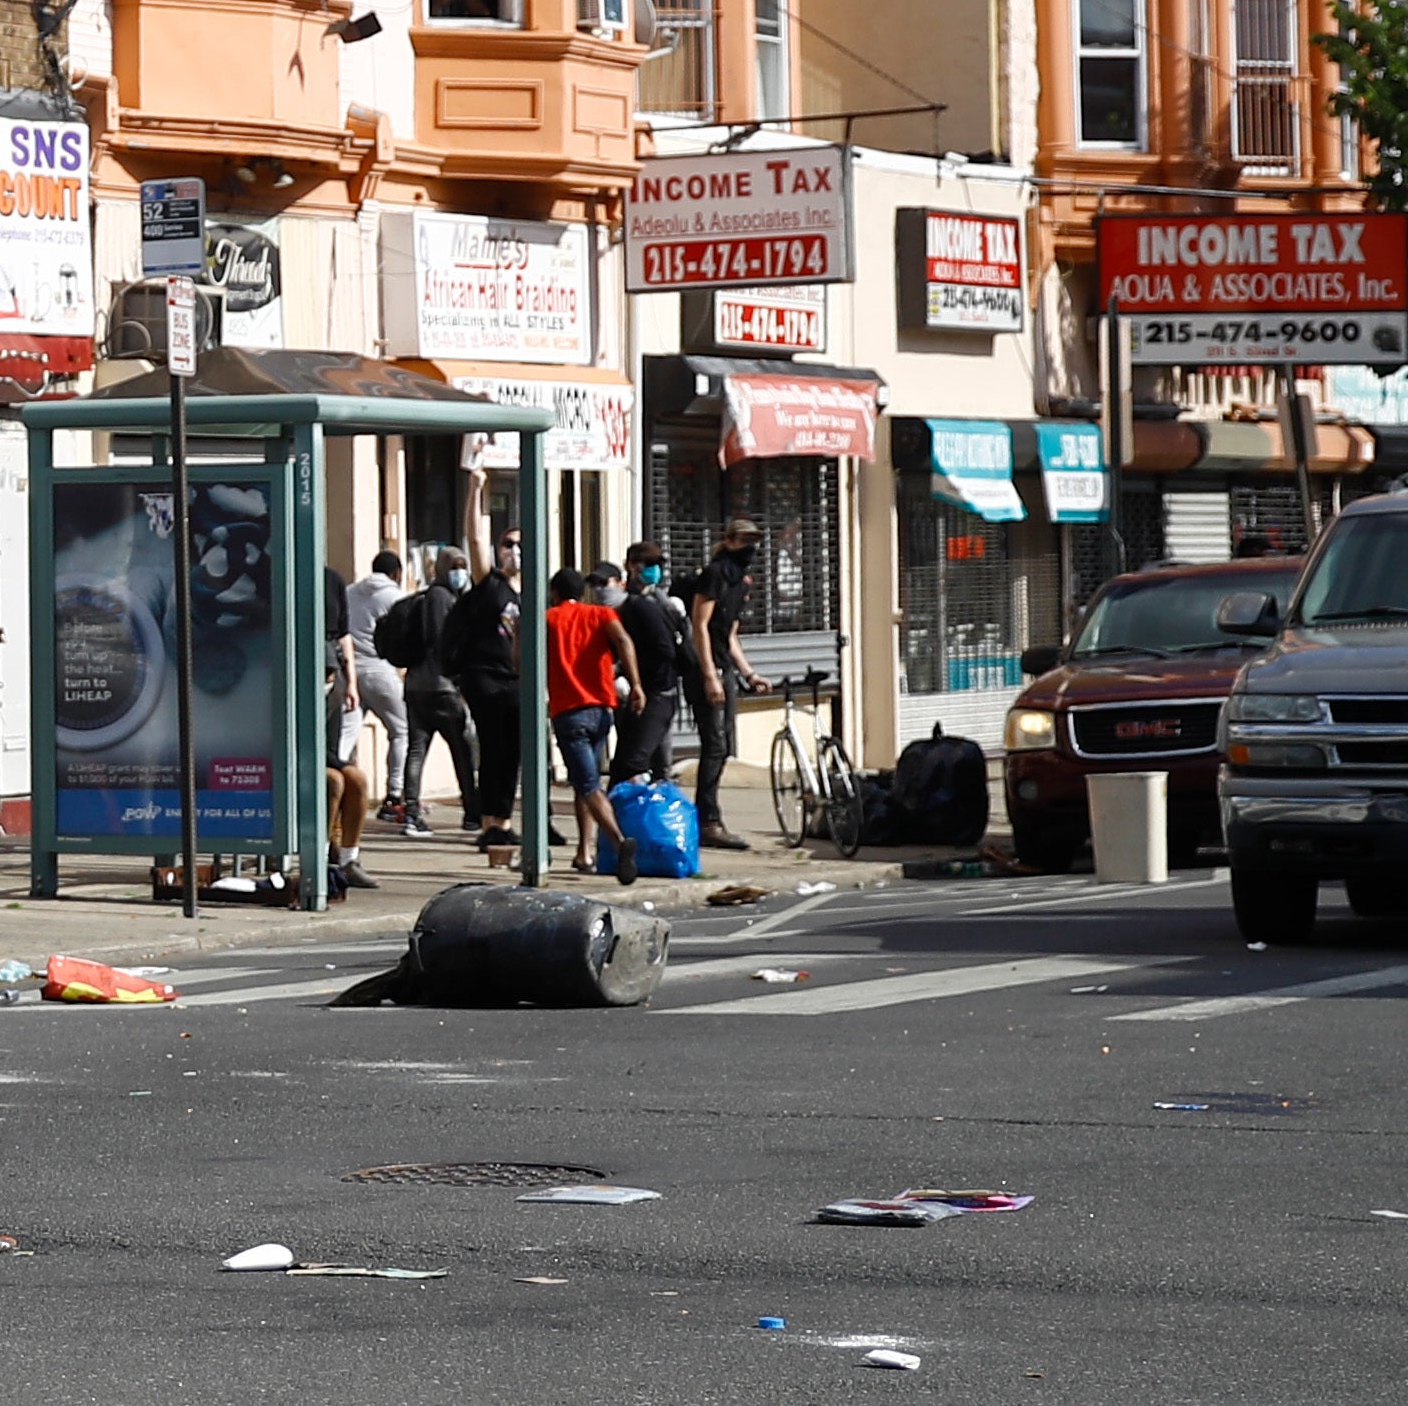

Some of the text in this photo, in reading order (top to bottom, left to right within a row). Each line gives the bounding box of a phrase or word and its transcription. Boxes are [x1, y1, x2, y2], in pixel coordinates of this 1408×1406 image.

[11, 126, 81, 171] SNS
[629, 160, 832, 203] INCOME TAX
[143, 202, 163, 220] 52
[693, 211, 704, 232] &
[709, 207, 800, 231] Associates
[927, 216, 1018, 264] INCOME TAX
[1138, 223, 1366, 266] INCOME TAX
[648, 239, 823, 282] 215-474-1794
[424, 268, 577, 324] African Hair Braiding
[1182, 275, 1201, 302] &
[1209, 272, 1351, 304] ASSOCIATES,
[1359, 273, 1399, 300] Inc.
[503, 315, 519, 328] ALL
[1146, 321, 1361, 344] 215-474-9600
[65, 677, 107, 688] turn to
[65, 690, 112, 701] LIHEAP
[1115, 719, 1181, 738] GMC
[225, 808, 240, 817] ALL
